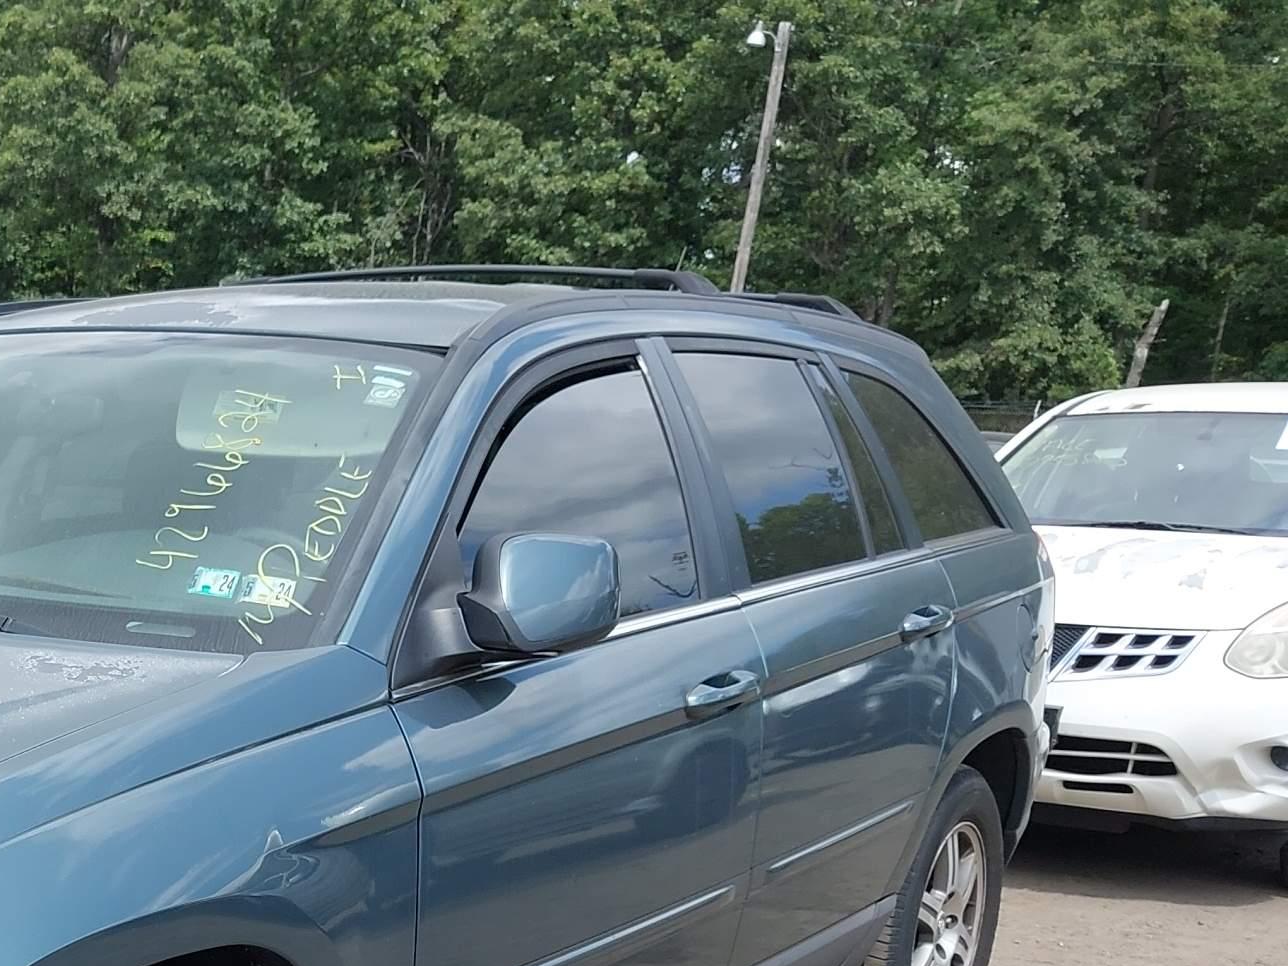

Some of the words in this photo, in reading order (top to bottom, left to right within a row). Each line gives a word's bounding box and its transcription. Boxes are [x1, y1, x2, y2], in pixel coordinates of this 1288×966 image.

[136, 389, 293, 569] 42966824
[219, 574, 236, 593] 24
[276, 582, 292, 601] 24
